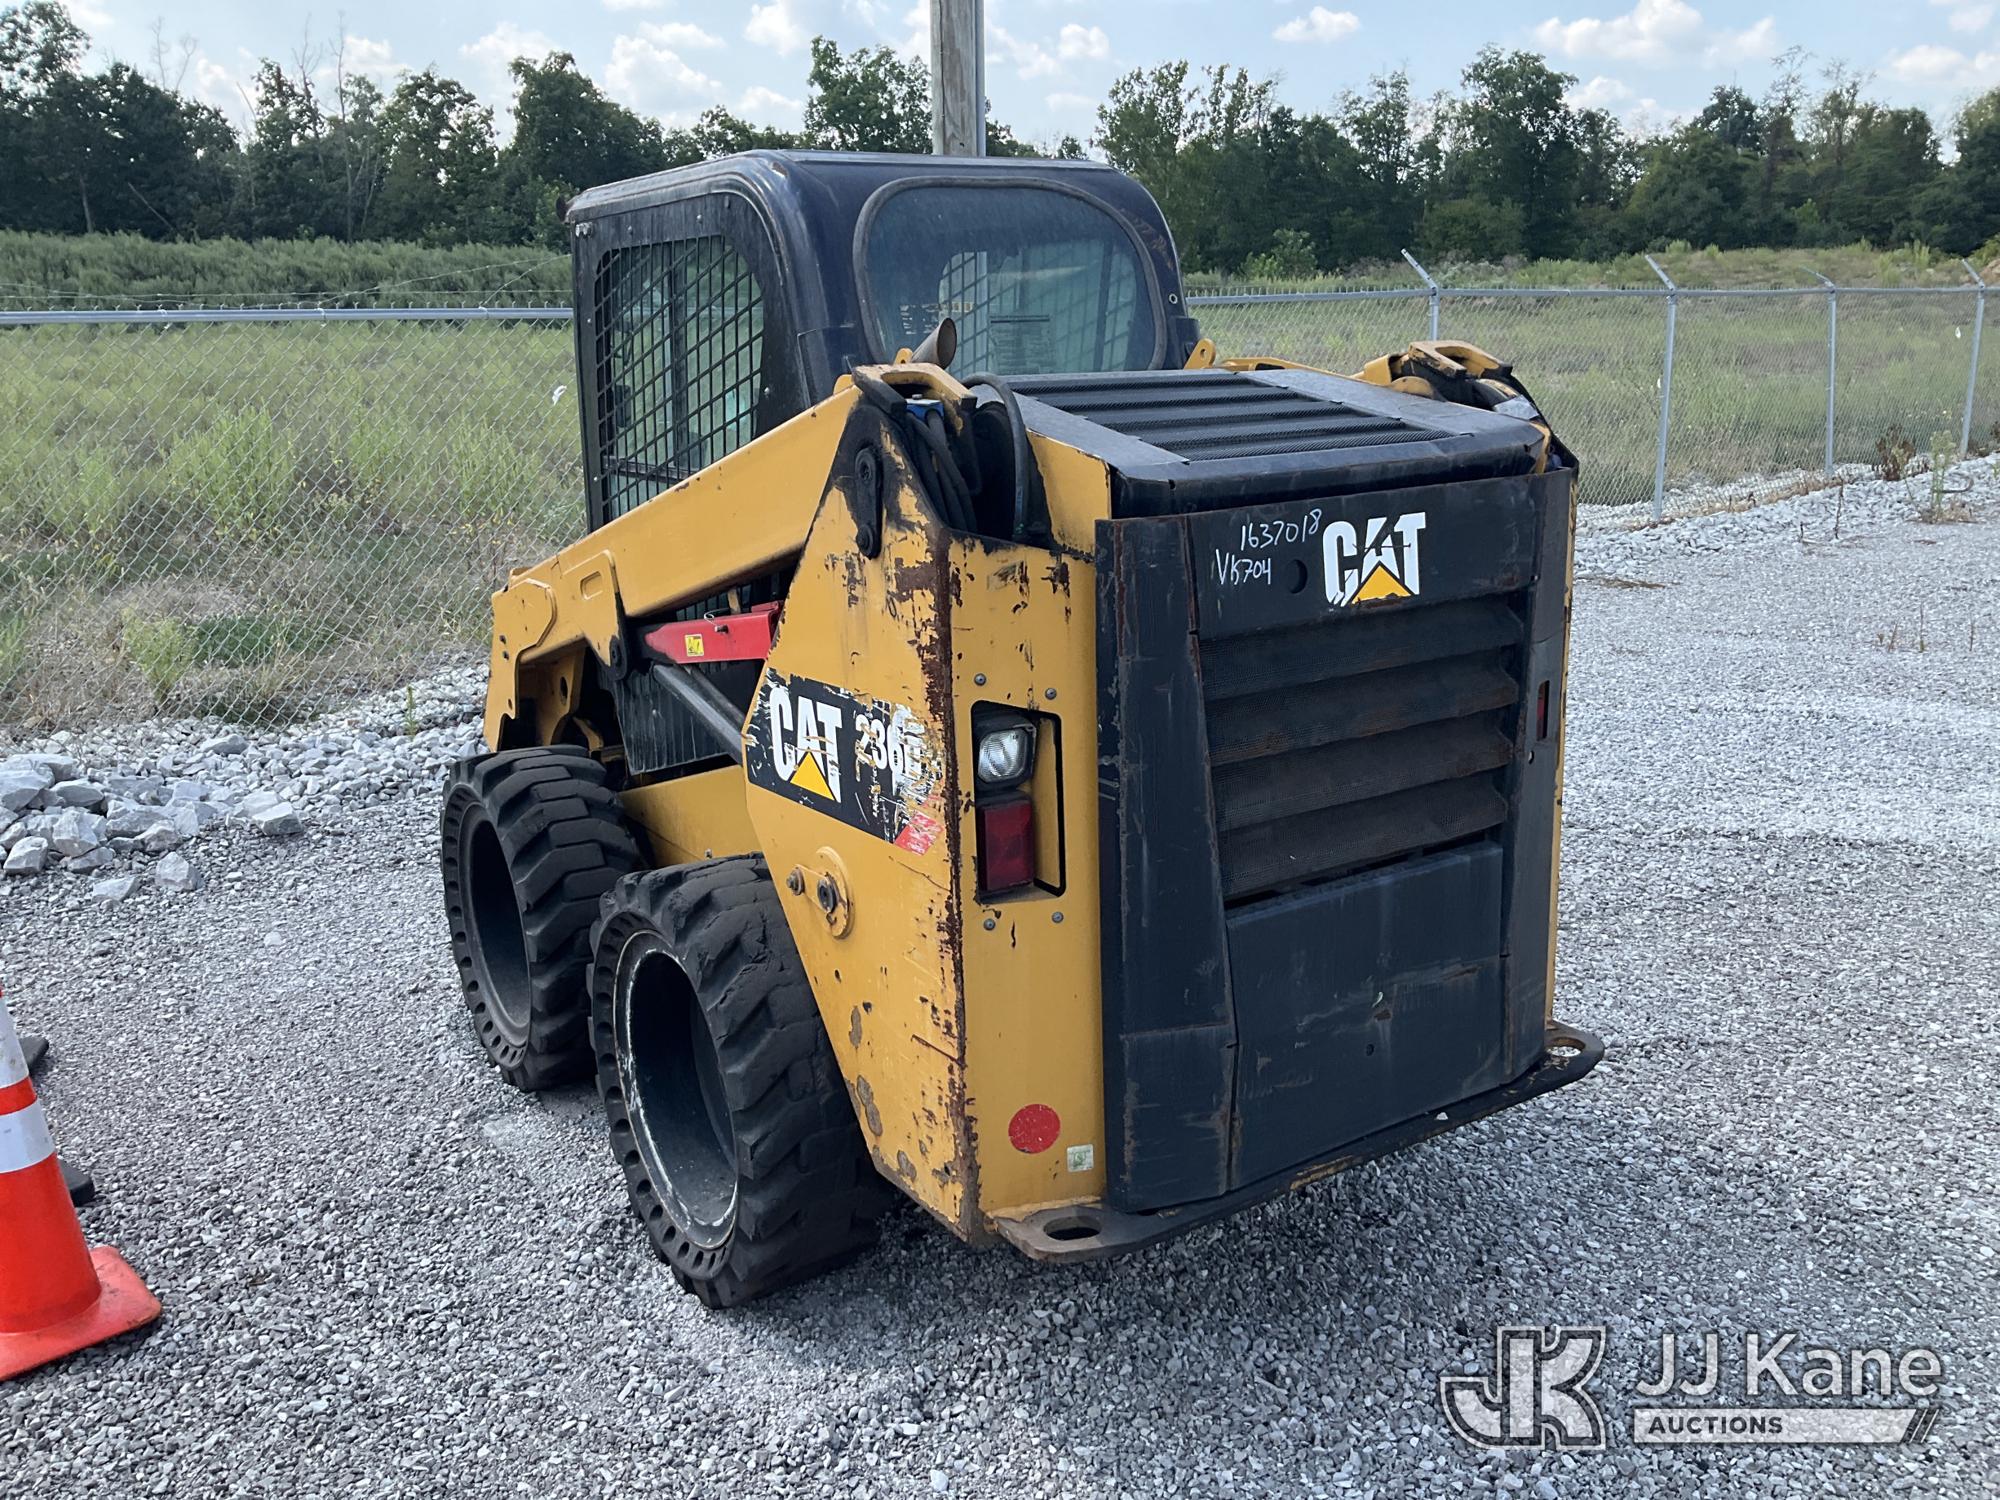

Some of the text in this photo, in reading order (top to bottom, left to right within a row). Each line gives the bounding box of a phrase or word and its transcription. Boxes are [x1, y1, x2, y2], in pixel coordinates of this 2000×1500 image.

[1241, 508, 1322, 551] 1637018
[1322, 511, 1426, 607] CAT
[769, 686, 843, 803] CAT
